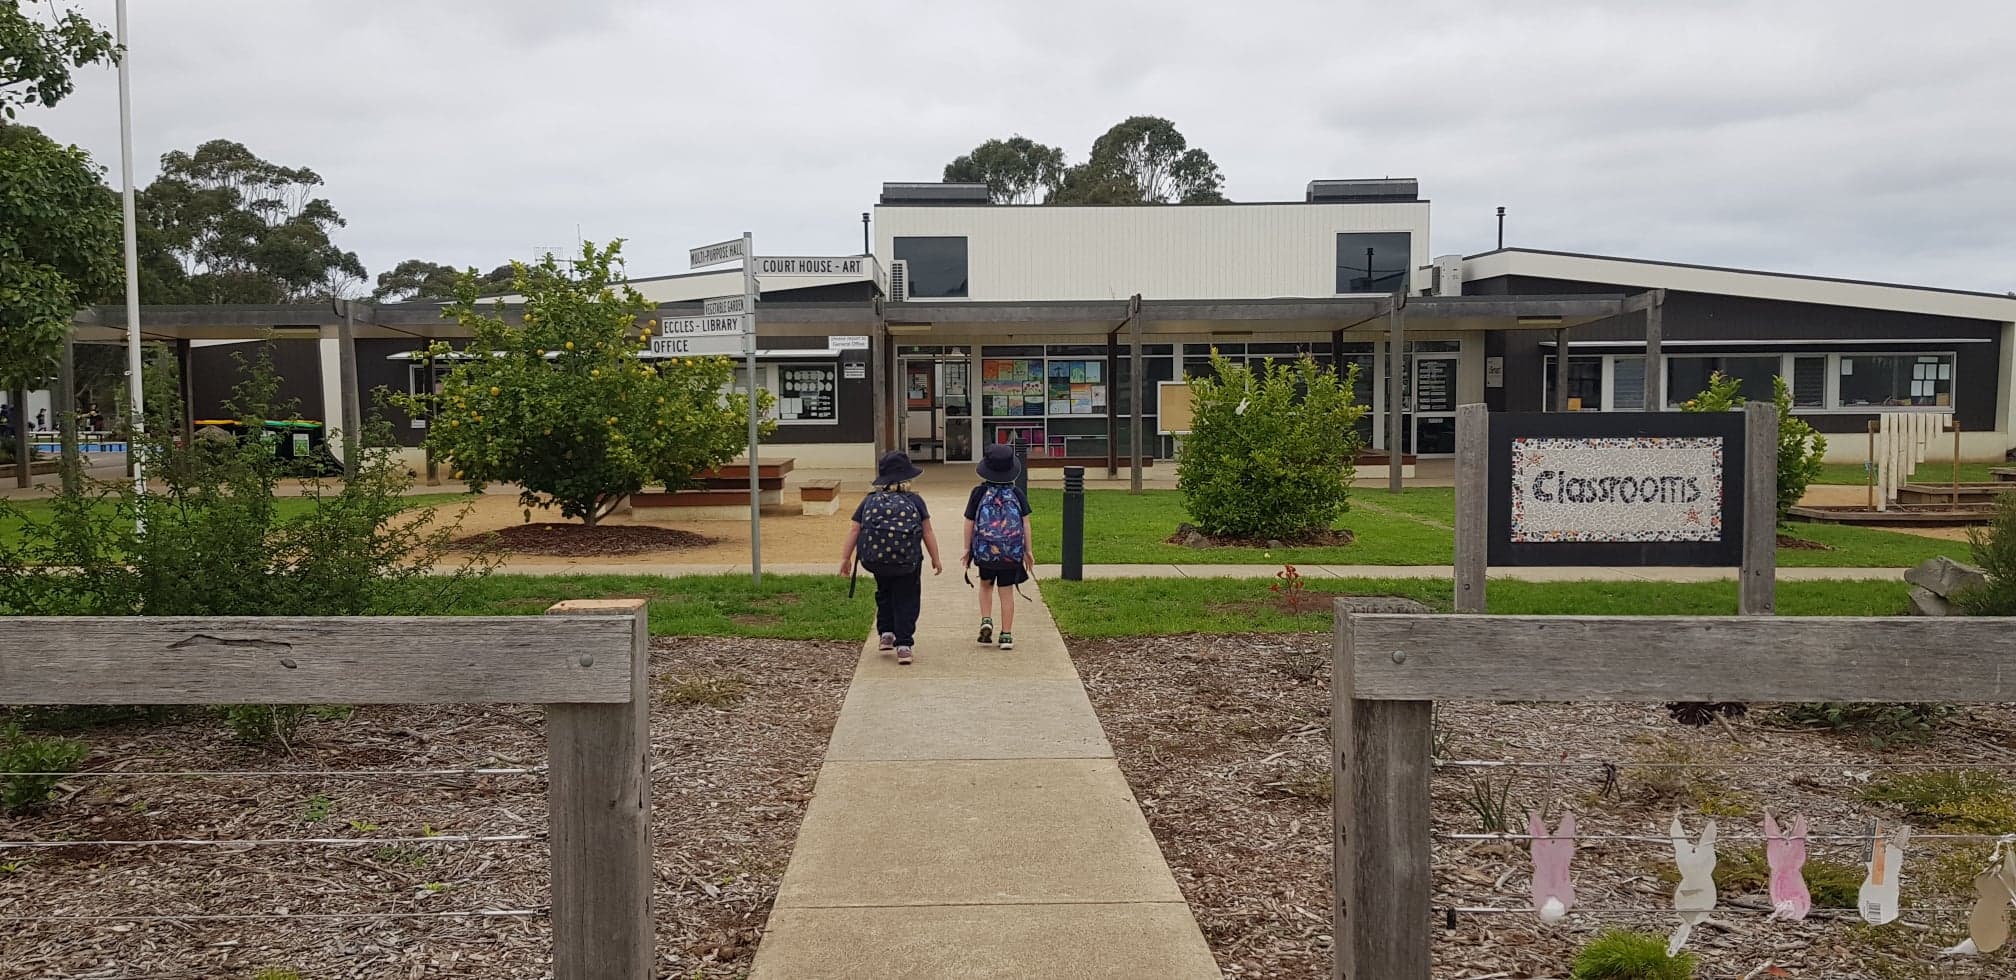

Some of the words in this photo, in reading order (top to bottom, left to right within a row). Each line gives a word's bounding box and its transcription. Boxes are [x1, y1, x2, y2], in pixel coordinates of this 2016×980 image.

[691, 245, 729, 265] MULTI-PURPOSE
[729, 242, 743, 257] HALL
[763, 259, 796, 273] COURT
[799, 259, 833, 273] HOUSE
[842, 259, 861, 273] ART
[705, 300, 728, 315] VEGETABLE
[727, 298, 745, 313] GARDEN
[664, 320, 695, 334] ECCLES
[702, 318, 738, 332] LIBRARY
[653, 340, 689, 353] OFFICE
[1531, 470, 1702, 504] Classrooms
